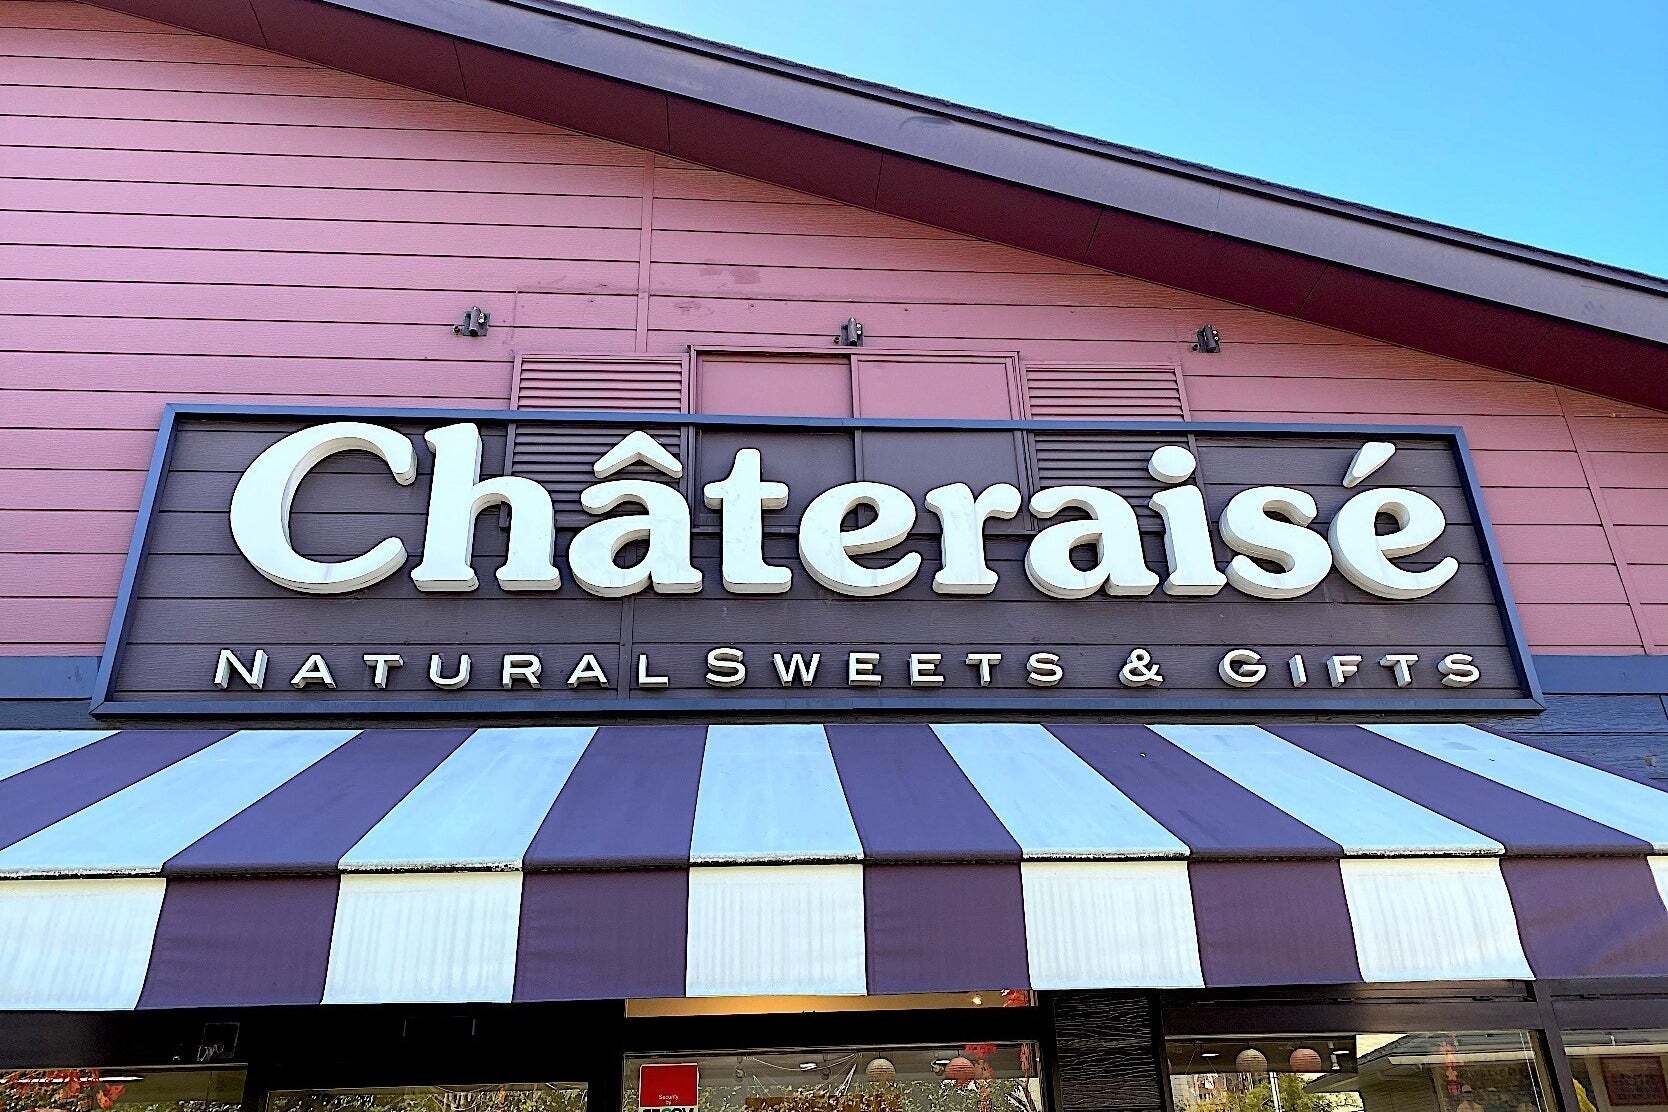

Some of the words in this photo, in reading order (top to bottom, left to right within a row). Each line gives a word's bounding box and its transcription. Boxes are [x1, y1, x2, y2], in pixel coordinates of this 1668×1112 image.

[229, 421, 1459, 599] Châteraisé
[213, 648, 670, 690] NATURAL
[706, 646, 1065, 687] SWEETS
[1119, 648, 1164, 688] &
[1218, 648, 1482, 688] GIFTS
